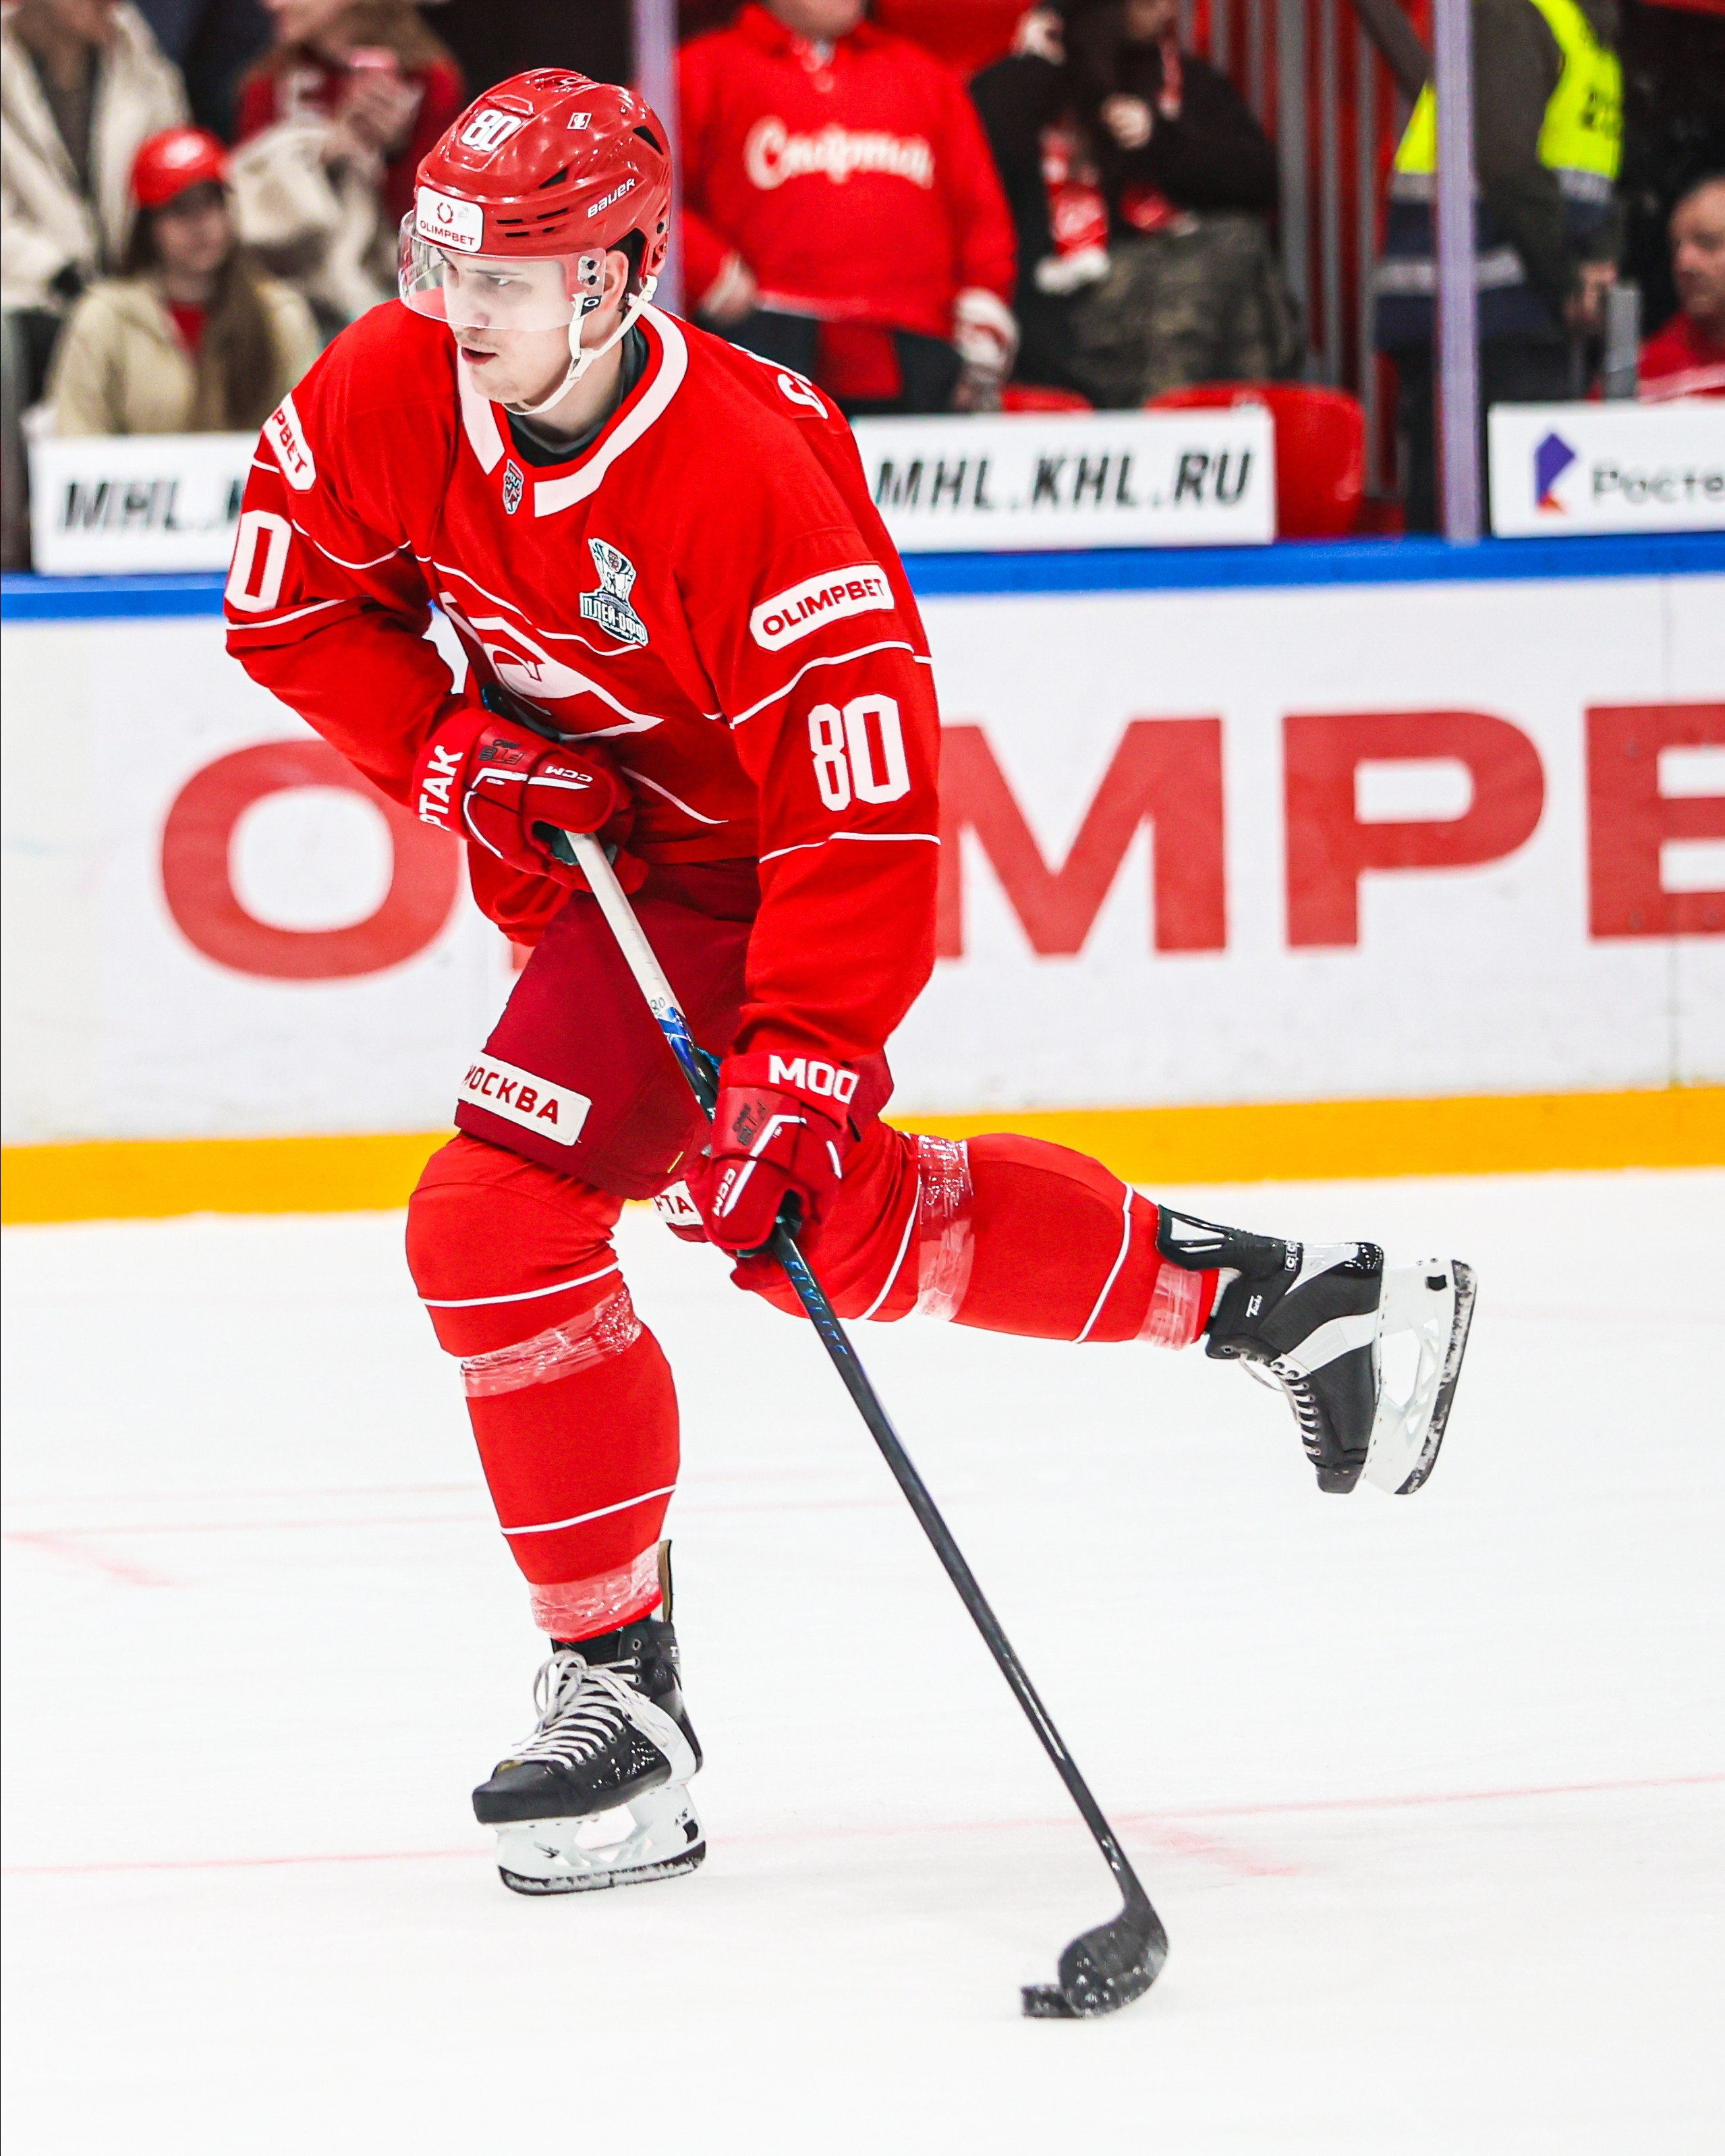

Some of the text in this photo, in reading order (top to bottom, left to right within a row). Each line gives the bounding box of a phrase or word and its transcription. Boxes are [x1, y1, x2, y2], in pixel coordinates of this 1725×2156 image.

[461, 109, 522, 152] 80
[420, 220, 476, 246] OLIMPBET
[762, 578, 884, 636] OLIMPBET
[544, 766, 593, 783] CCM
[808, 693, 911, 812] 80
[712, 1168, 737, 1217] CCM
